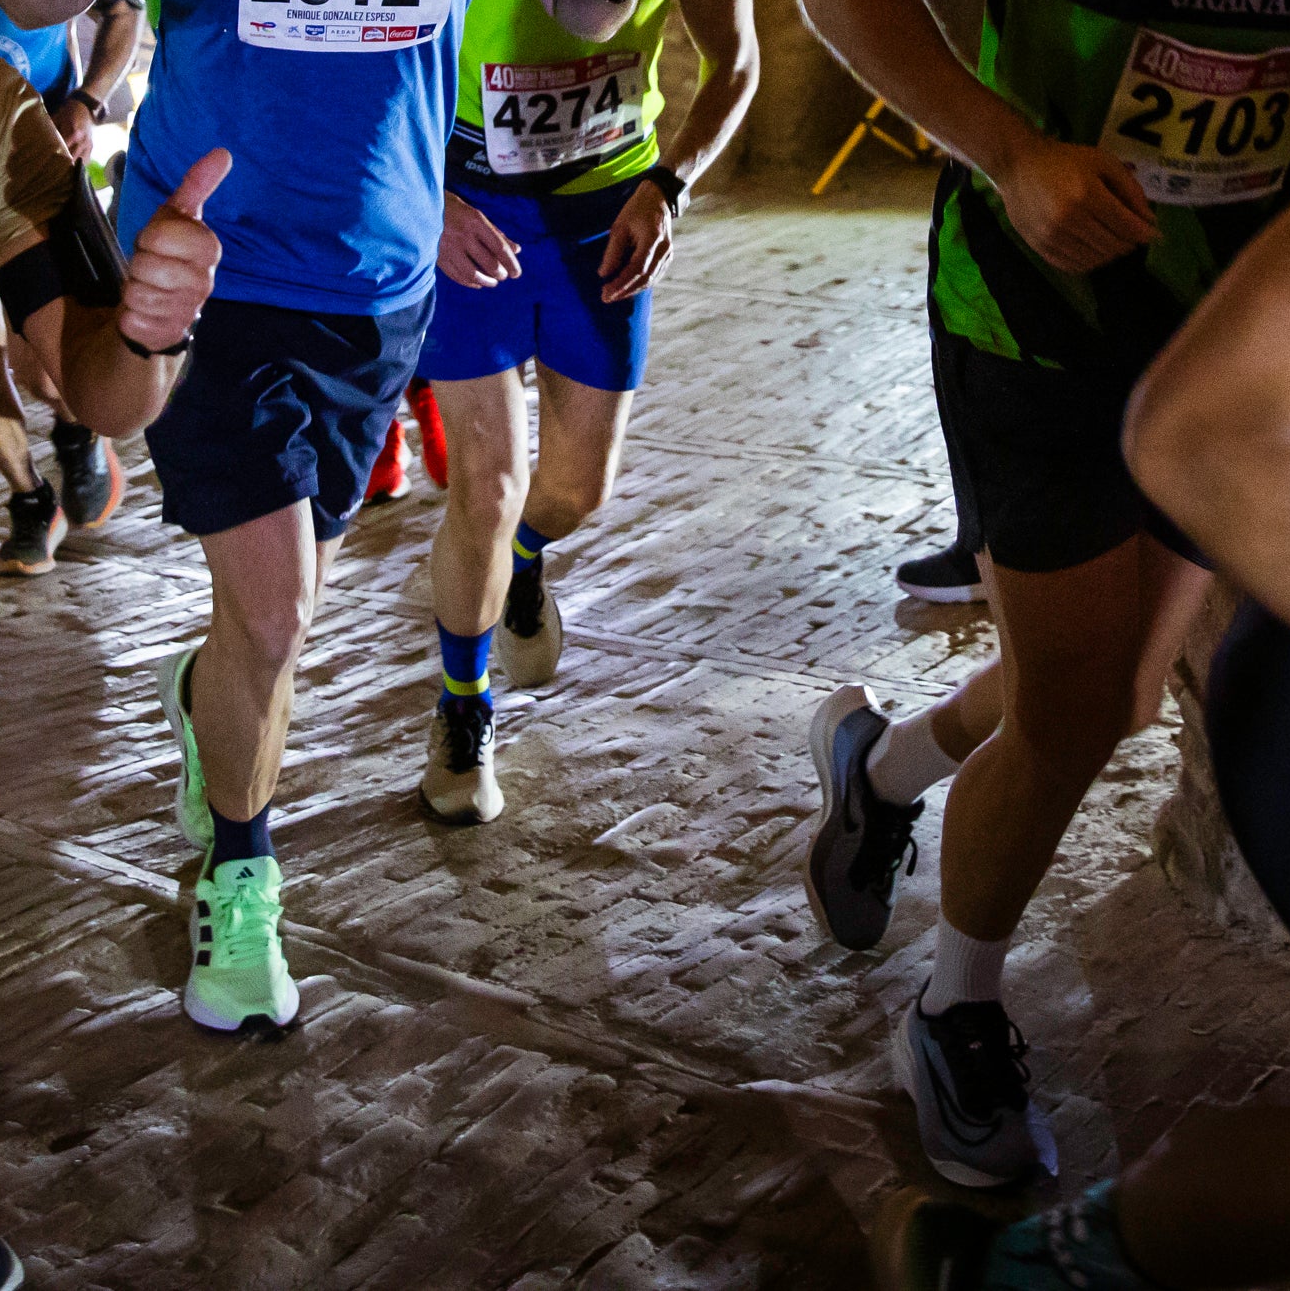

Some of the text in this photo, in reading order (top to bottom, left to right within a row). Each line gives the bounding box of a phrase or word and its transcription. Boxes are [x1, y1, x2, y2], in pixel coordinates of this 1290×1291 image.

[286, 9, 396, 22] ENRIQUE GONZALEZ ESPESO
[490, 65, 514, 89] 40
[493, 75, 623, 136] 4274
[1117, 82, 1290, 157] 2103
